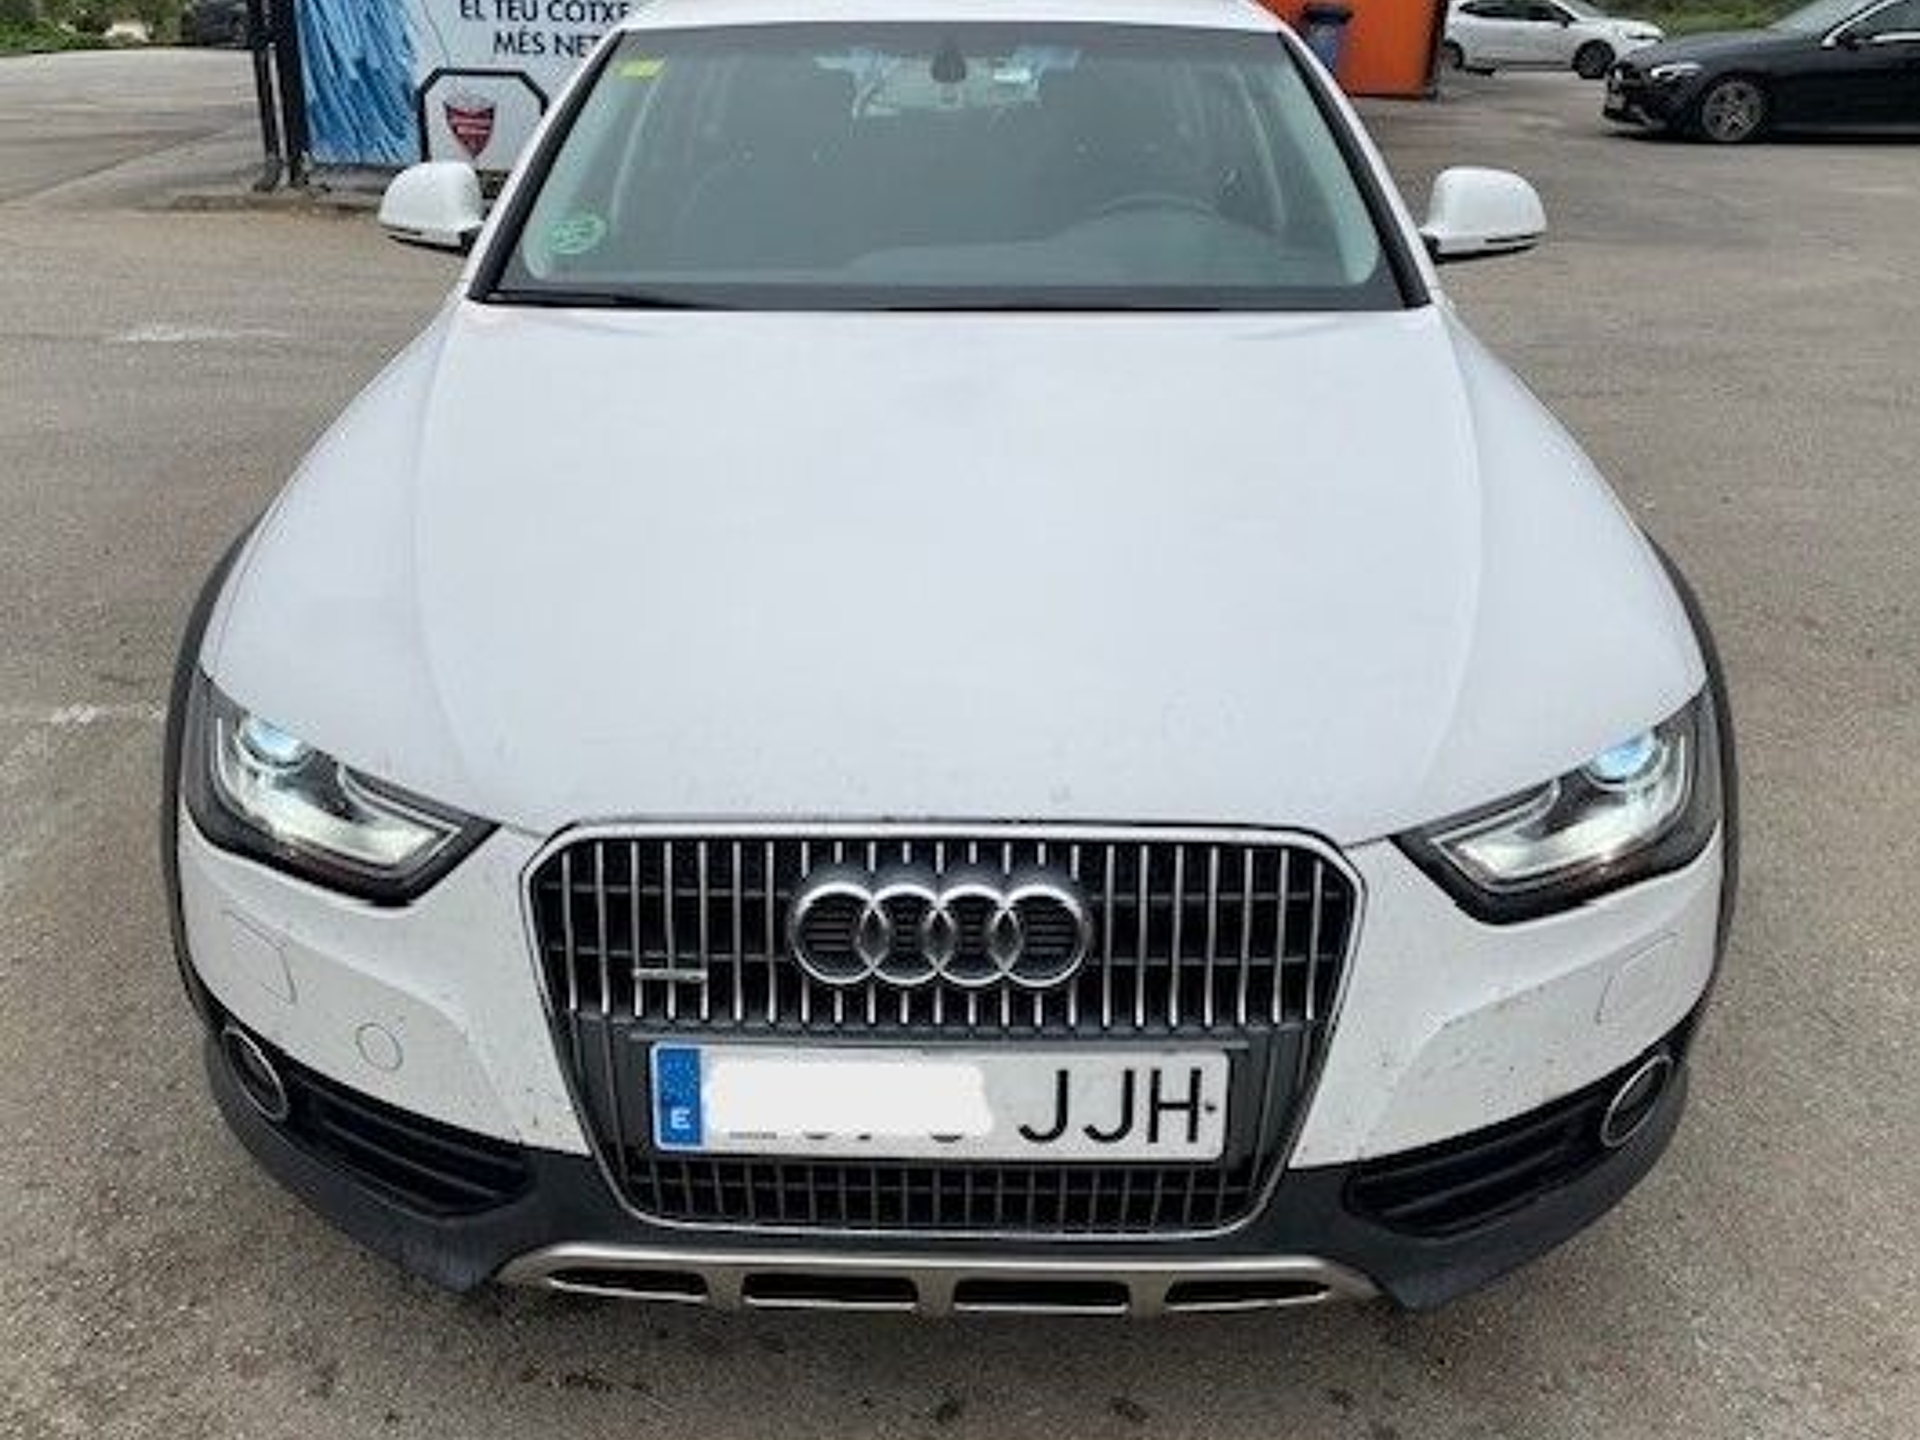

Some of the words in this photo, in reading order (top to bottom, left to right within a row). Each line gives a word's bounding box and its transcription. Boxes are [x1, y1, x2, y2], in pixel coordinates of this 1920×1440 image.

[460, 0, 486, 20] EL
[494, 0, 538, 21] TEU
[494, 25, 545, 55] MÉS
[670, 1107, 691, 1130] E
[1018, 1069, 1202, 1143] JJH
